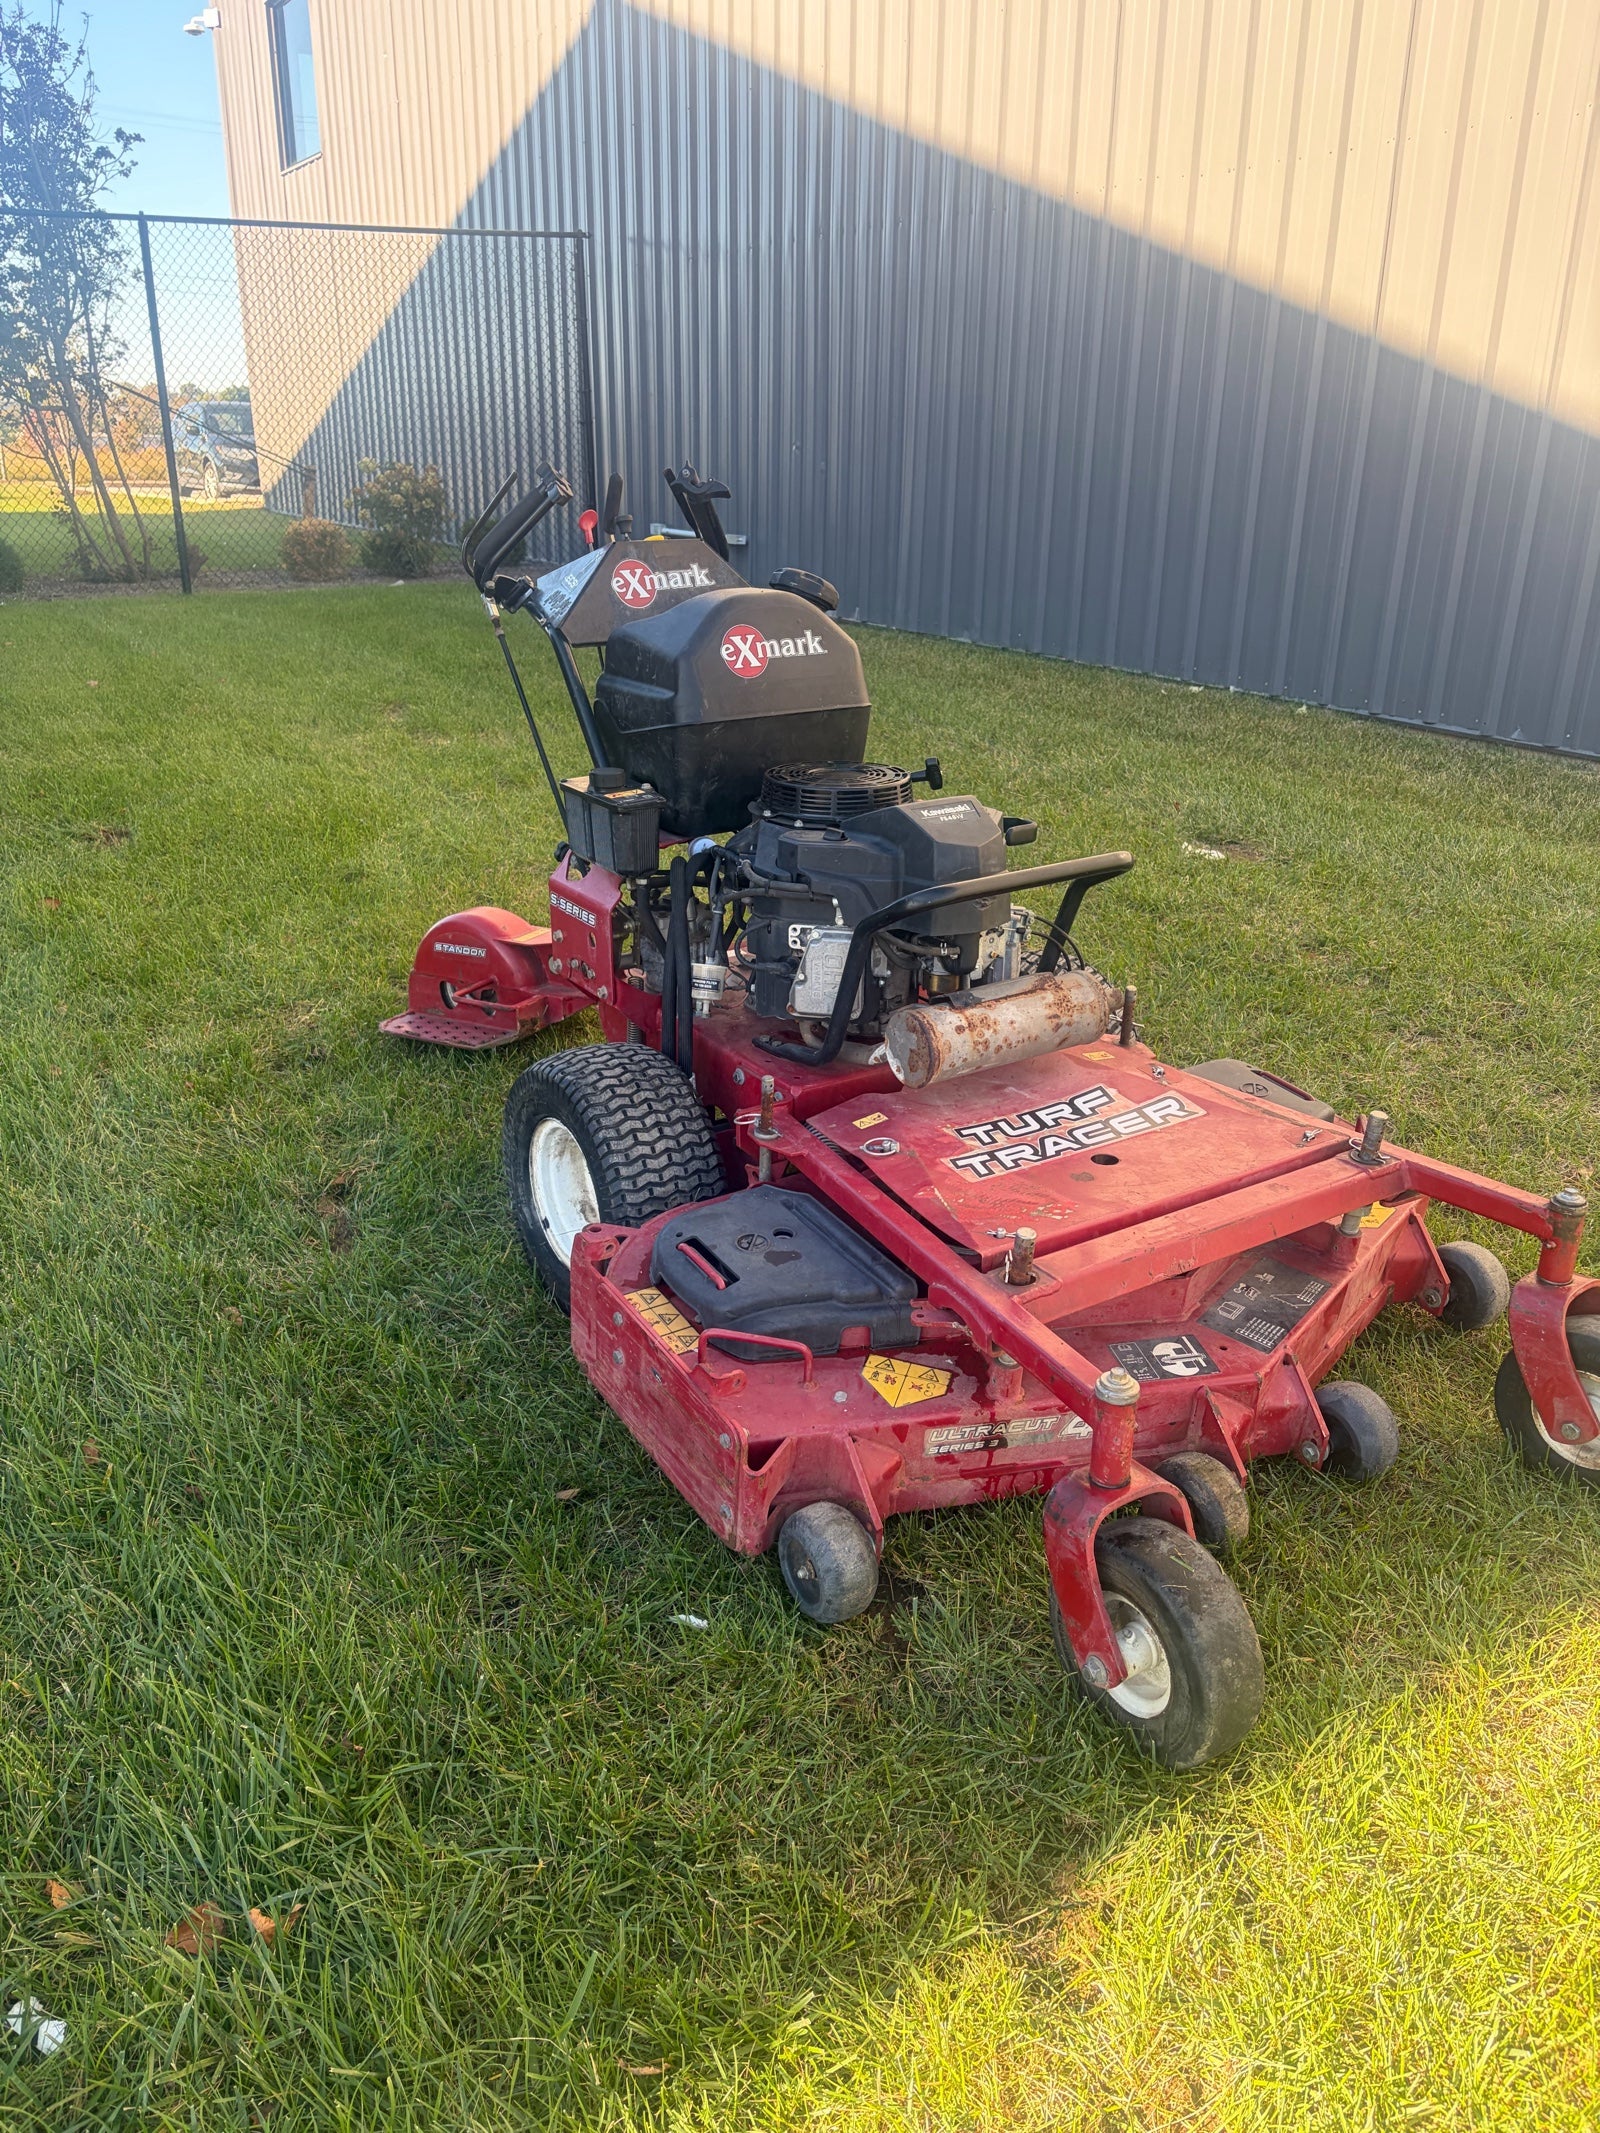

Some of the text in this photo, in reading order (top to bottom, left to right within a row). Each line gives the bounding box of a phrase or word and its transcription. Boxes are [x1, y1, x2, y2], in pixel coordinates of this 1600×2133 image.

[611, 562, 715, 601] eXmark
[720, 629, 828, 670] eXmark
[920, 803, 971, 817] Kawasaki
[435, 943, 486, 957] STANDON
[955, 1086, 1116, 1147] TURF
[950, 1096, 1200, 1179] TRACER
[929, 1415, 1060, 1443] ULTRACUT
[928, 1438, 999, 1455] SERIES 3
